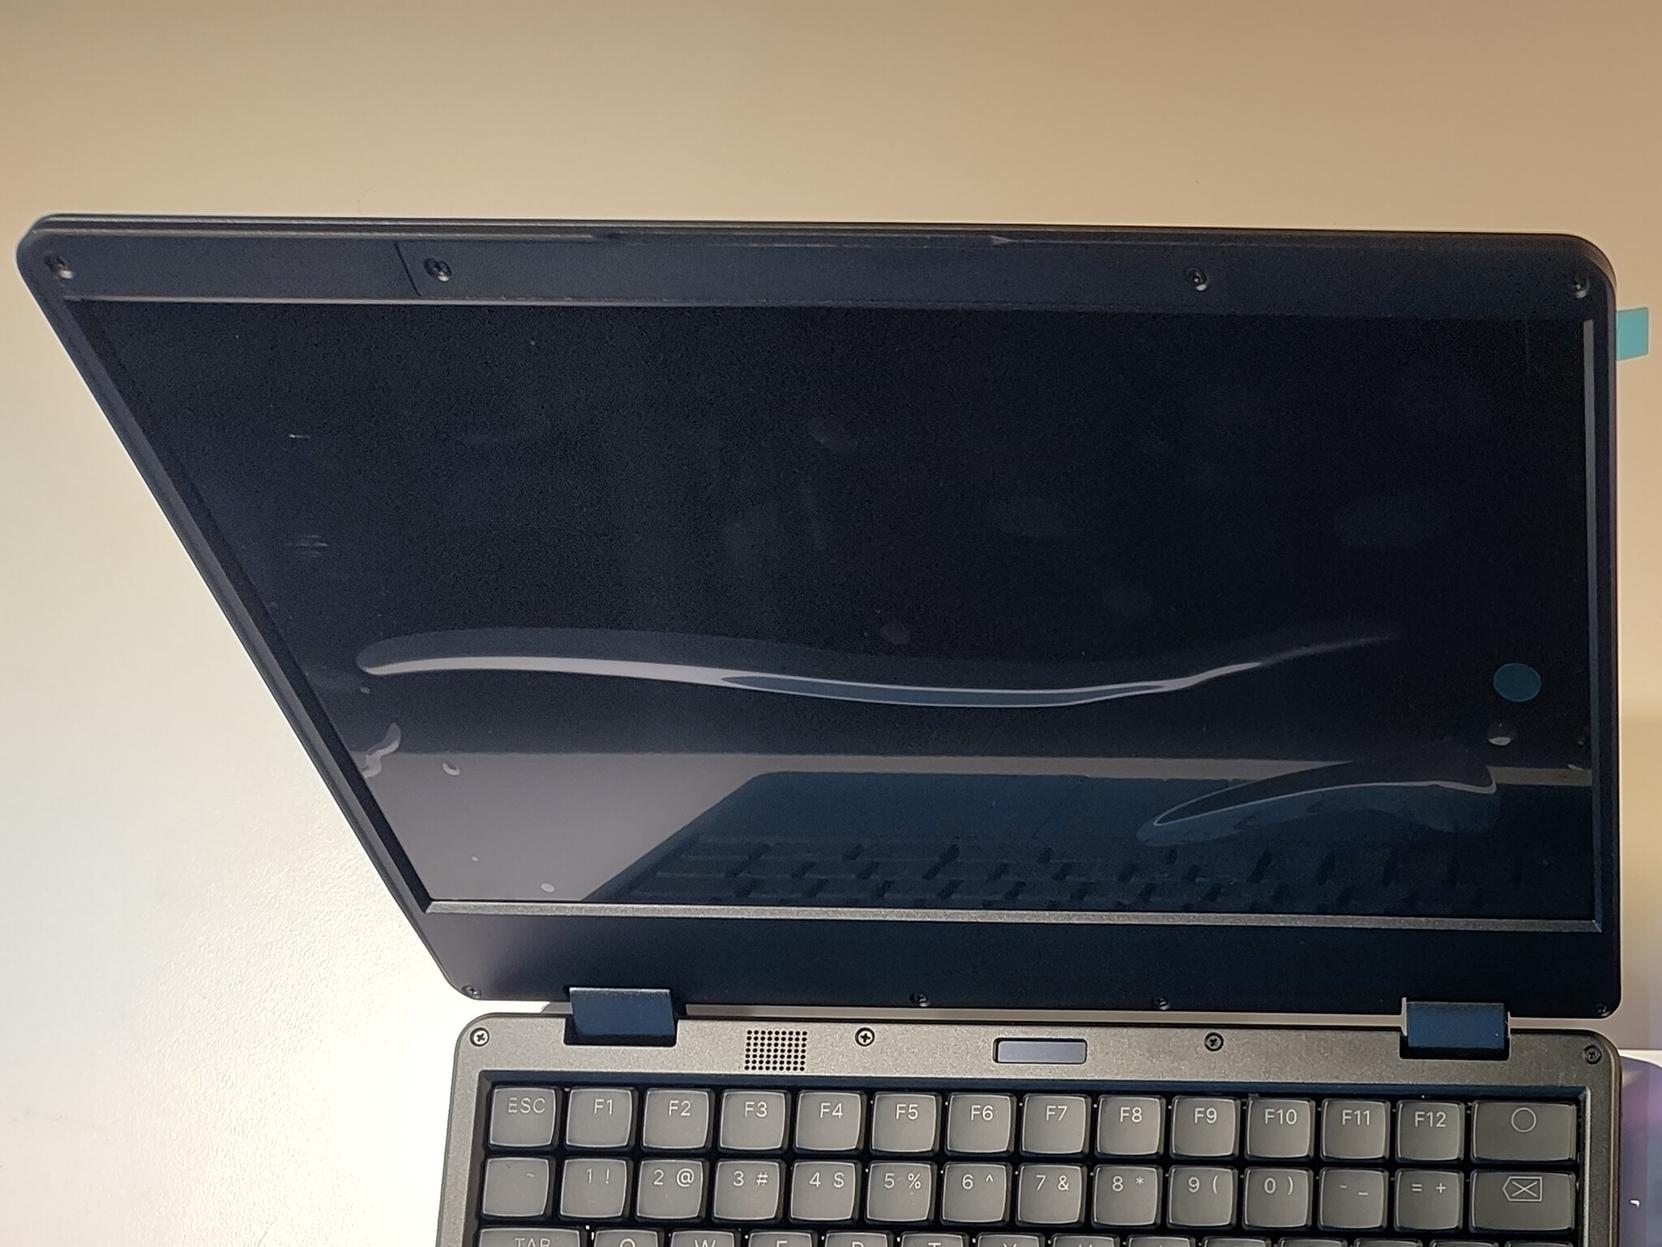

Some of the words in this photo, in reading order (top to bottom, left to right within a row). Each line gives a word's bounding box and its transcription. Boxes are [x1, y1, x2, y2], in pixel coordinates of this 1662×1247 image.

[508, 1098, 546, 1115] ESC
[594, 1099, 614, 1115] F1
[669, 1101, 691, 1116] F2
[744, 1101, 767, 1118] F3
[820, 1103, 843, 1119] F4
[895, 1104, 919, 1120] F5
[971, 1106, 993, 1121] F6
[1046, 1105, 1067, 1121] F7
[1120, 1107, 1142, 1123] F8
[1194, 1108, 1217, 1123] F9
[1265, 1108, 1297, 1125] F10
[1342, 1110, 1371, 1126] F11
[1415, 1112, 1446, 1128] F12
[653, 1170, 664, 1186] 2
[733, 1171, 745, 1186] 3
[810, 1171, 821, 1187] 4
[884, 1172, 895, 1188] 5
[962, 1174, 973, 1190] 6
[1035, 1175, 1046, 1191] 7
[1112, 1176, 1123, 1191] 8
[1189, 1177, 1199, 1192] 9
[1264, 1178, 1275, 1194] 0
